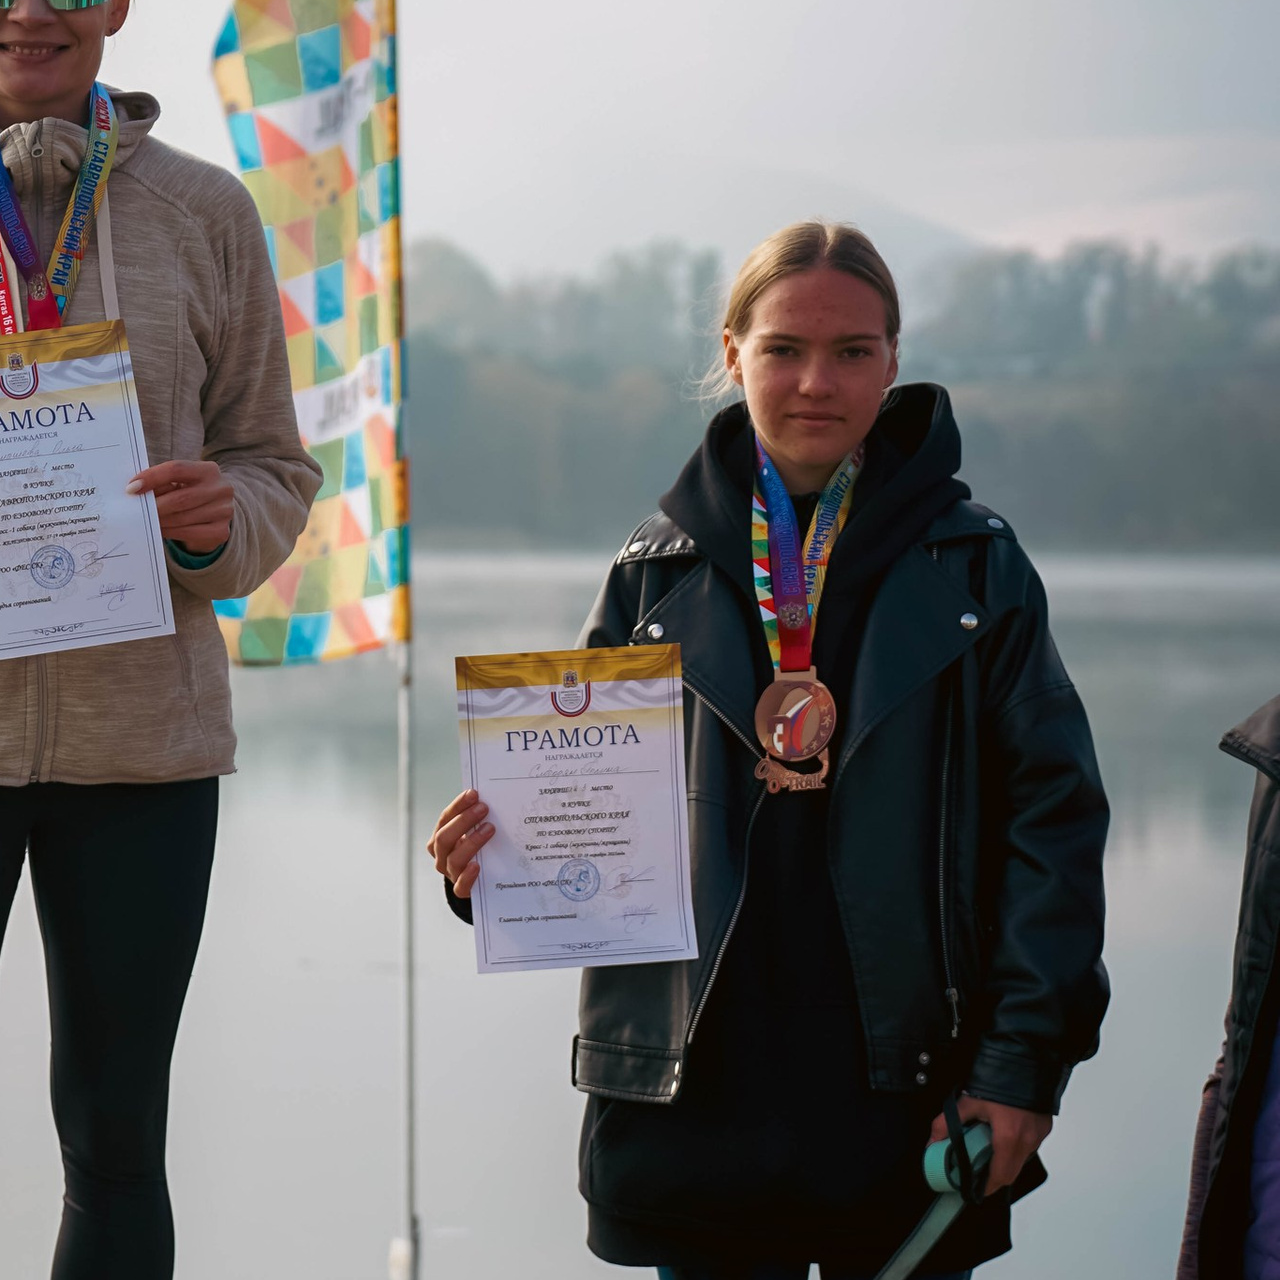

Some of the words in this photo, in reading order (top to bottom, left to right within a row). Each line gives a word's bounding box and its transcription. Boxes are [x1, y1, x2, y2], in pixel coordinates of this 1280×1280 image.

[61, 140, 109, 253] СТАВРОПОЛЬСКИЙ
[50, 252, 74, 286] КРАЙ
[2, 314, 13, 326] 16
[0, 431, 58, 444] НАГРАЖДАЕТСЯ
[51, 463, 74, 471] место
[73, 487, 96, 497] КРАЯ
[1, 514, 12, 522] ПО
[13, 507, 54, 520] ЕЗДОВОМУ
[54, 503, 87, 514] СПОРТУ
[505, 724, 640, 751] ГРАМОТА
[545, 751, 603, 761] НАГРАЖДАЕТСЯ
[608, 810, 631, 818] КРАЯ
